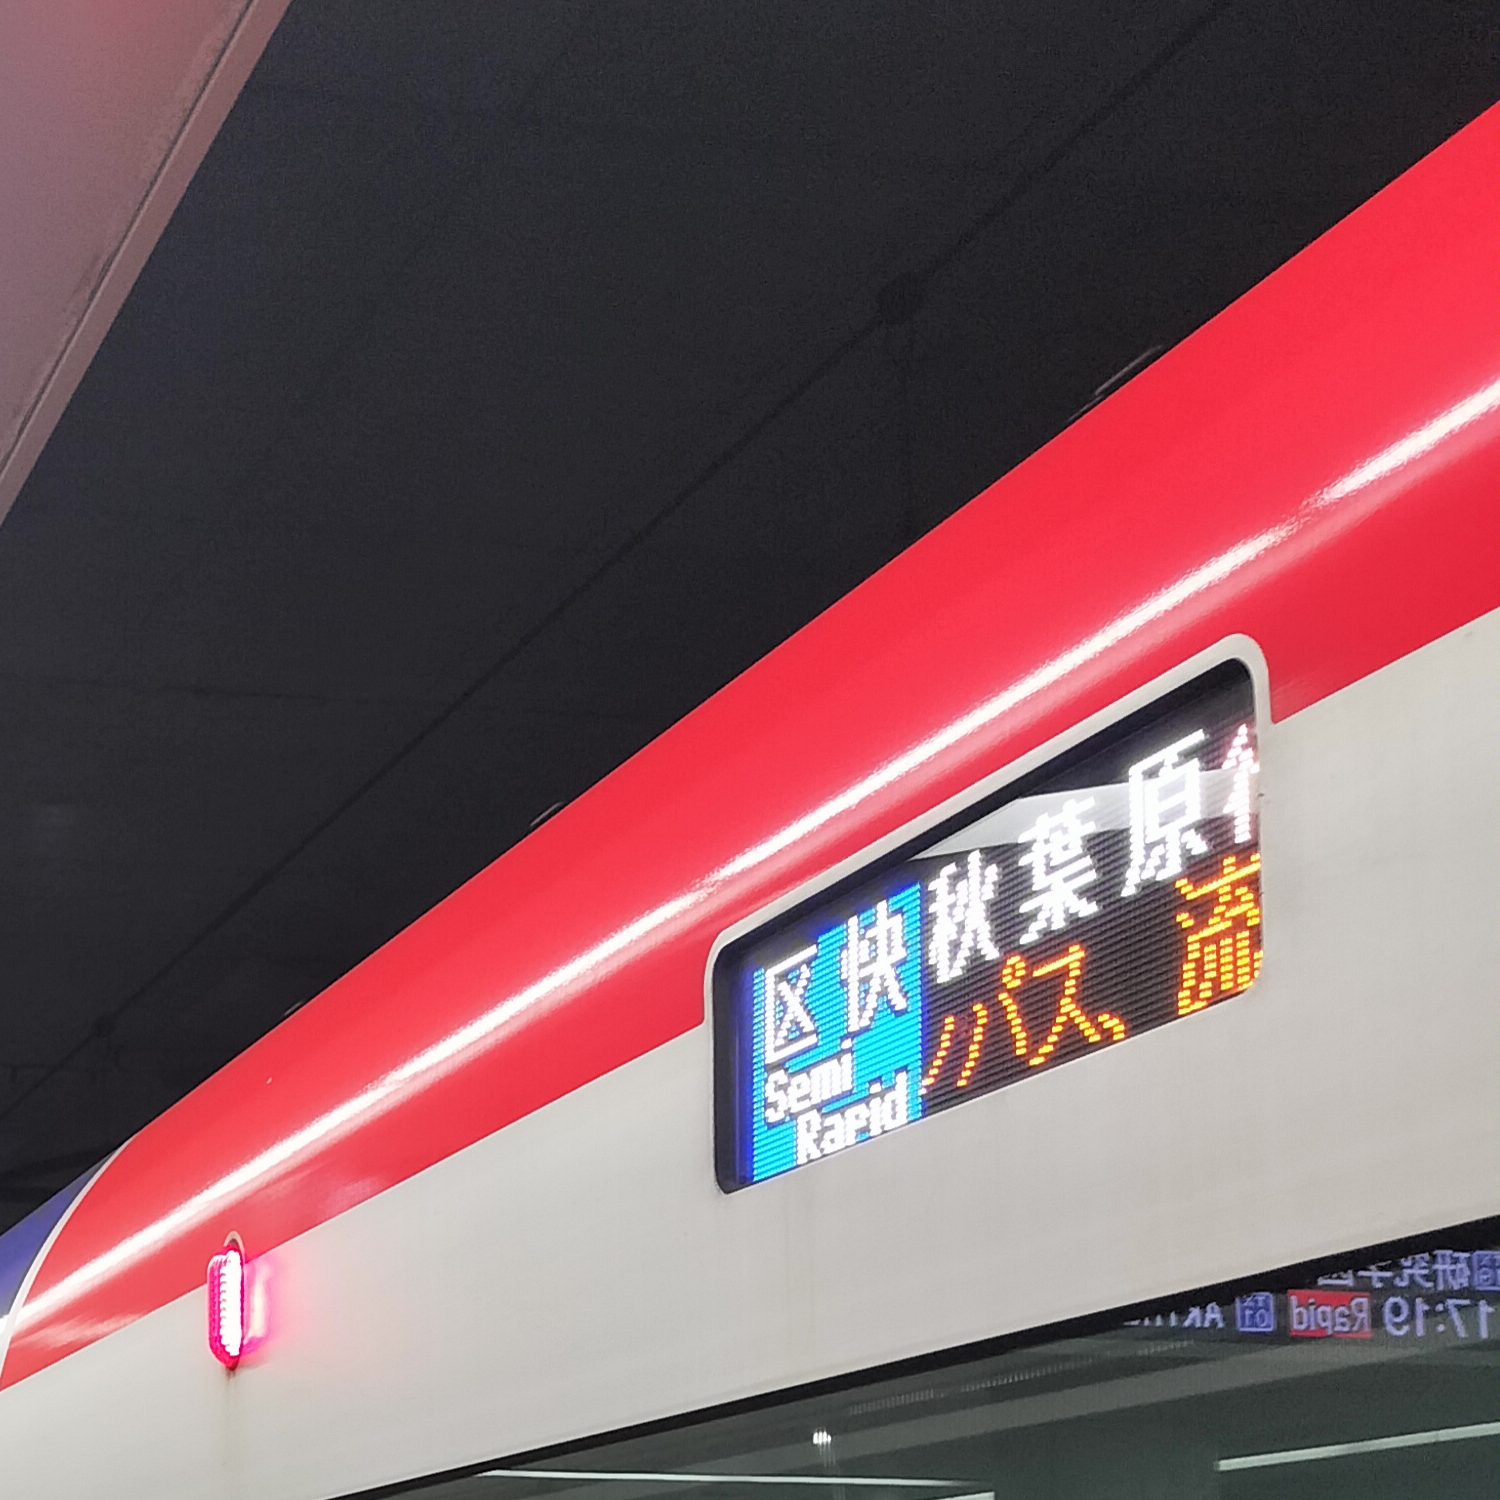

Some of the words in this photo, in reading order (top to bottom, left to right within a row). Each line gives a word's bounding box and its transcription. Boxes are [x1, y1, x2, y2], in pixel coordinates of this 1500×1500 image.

[765, 898, 908, 1065] 区快
[765, 1037, 854, 1124] Semi
[796, 1070, 909, 1165] Rapid
